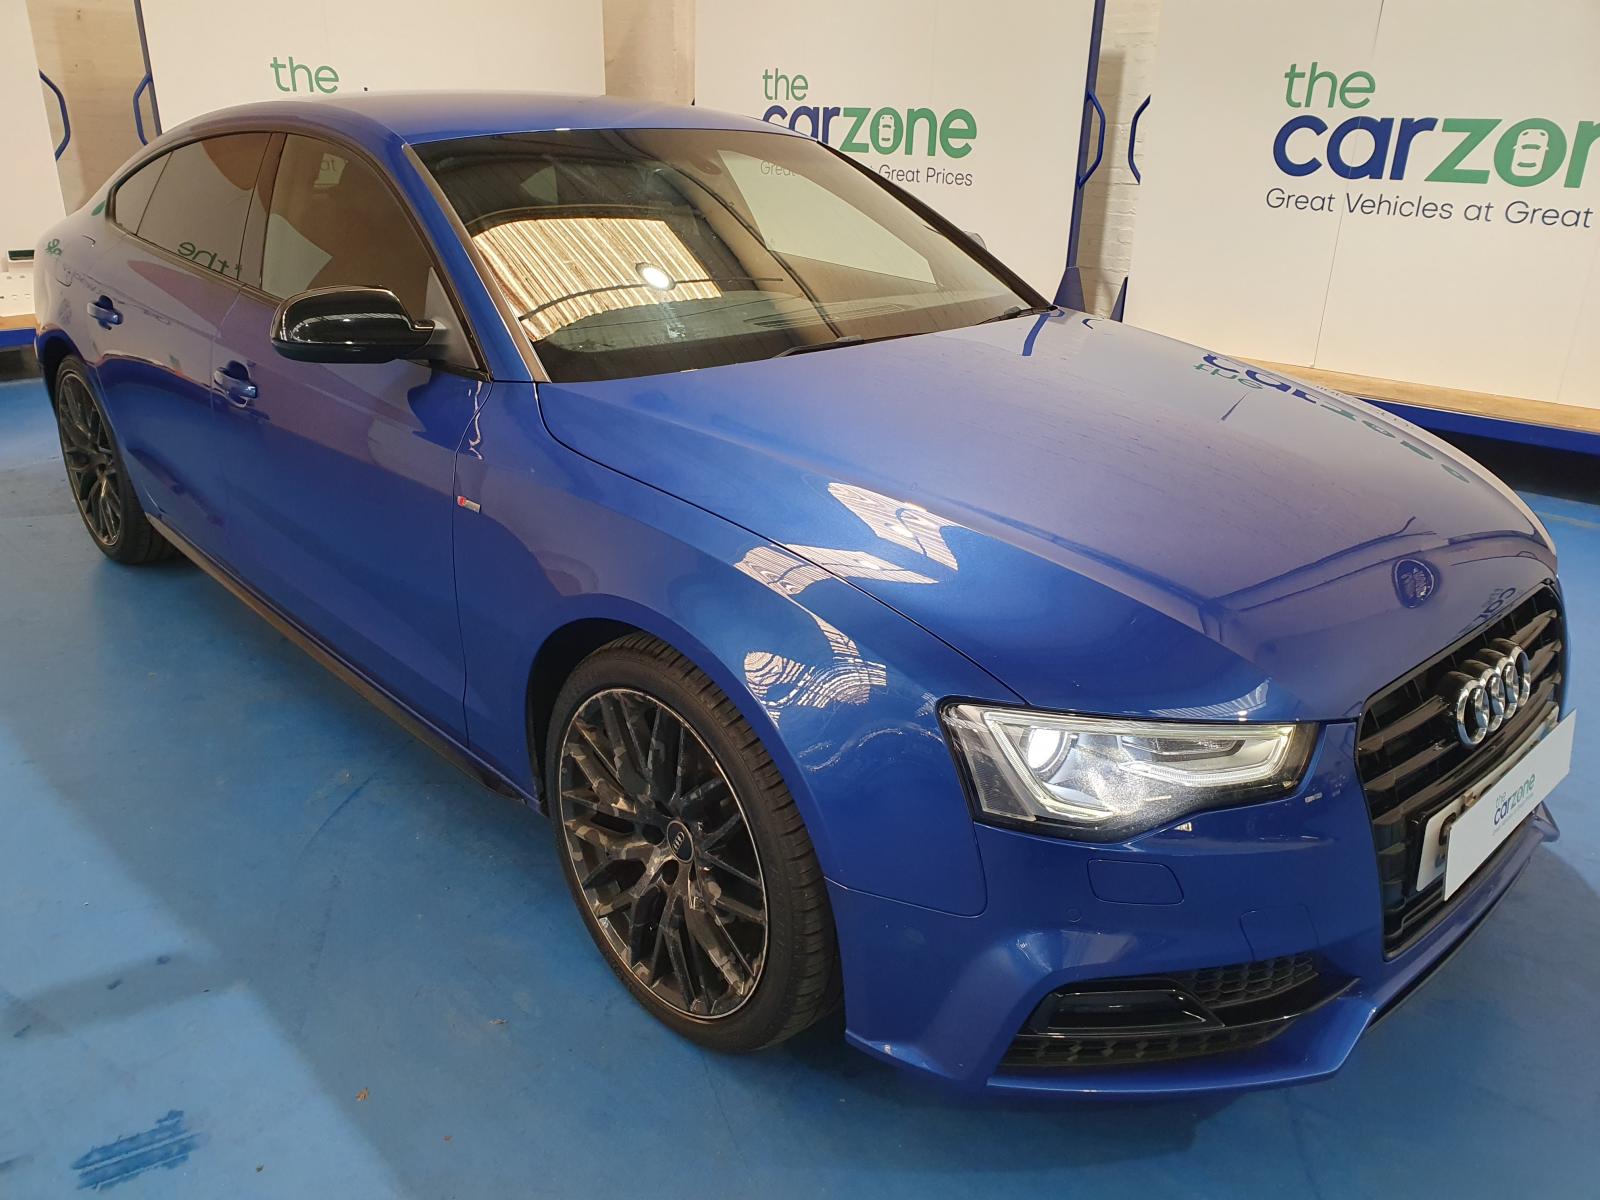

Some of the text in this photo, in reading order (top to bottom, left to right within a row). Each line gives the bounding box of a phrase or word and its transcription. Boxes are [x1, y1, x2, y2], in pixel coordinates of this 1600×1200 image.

[269, 56, 339, 94] the
[762, 68, 809, 101] the
[1284, 61, 1376, 109] the
[879, 164, 921, 183] Great
[926, 167, 973, 187] Prices
[1265, 187, 1594, 229] Great Vehicles at Great
